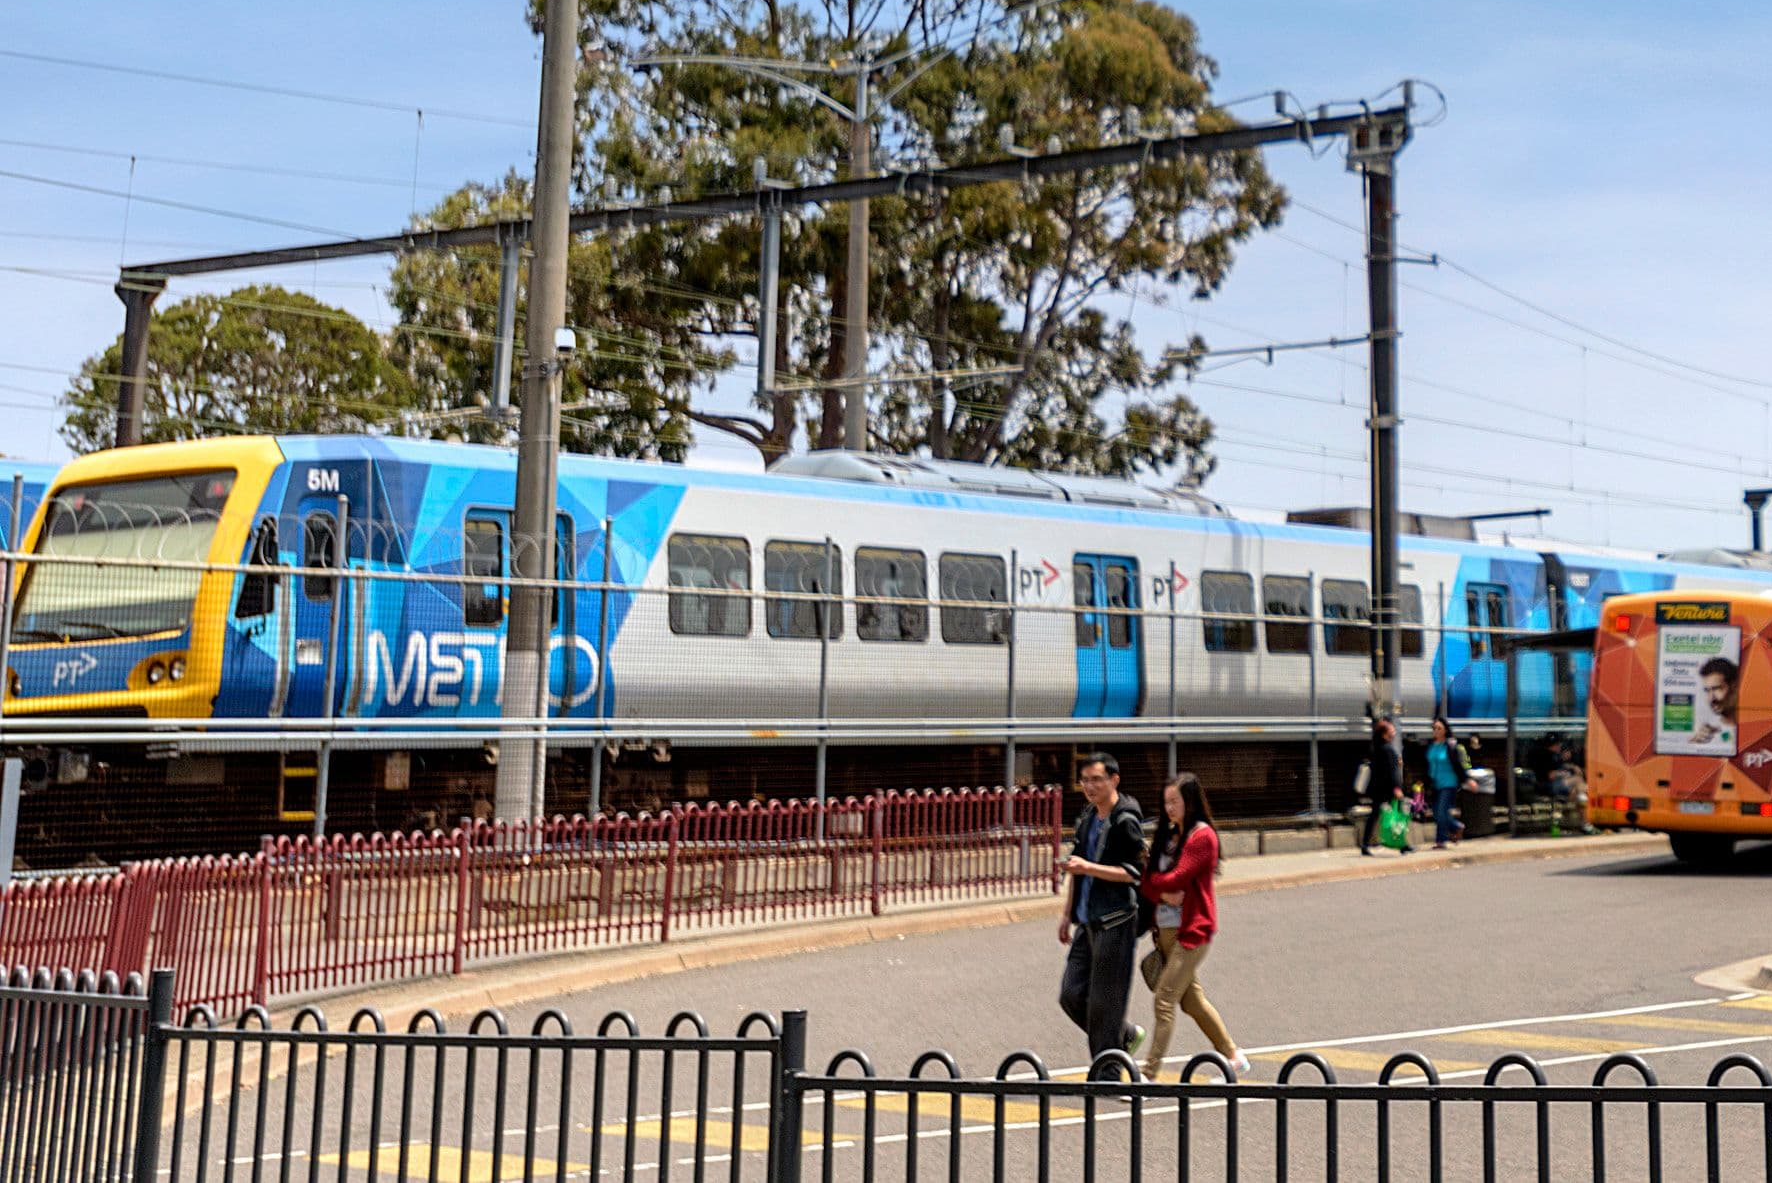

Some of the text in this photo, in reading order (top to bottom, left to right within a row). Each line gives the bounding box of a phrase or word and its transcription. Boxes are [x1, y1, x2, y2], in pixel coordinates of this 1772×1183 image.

[307, 469, 340, 491] 5M
[1659, 603, 1727, 621] Ventura
[363, 630, 600, 707] METO
